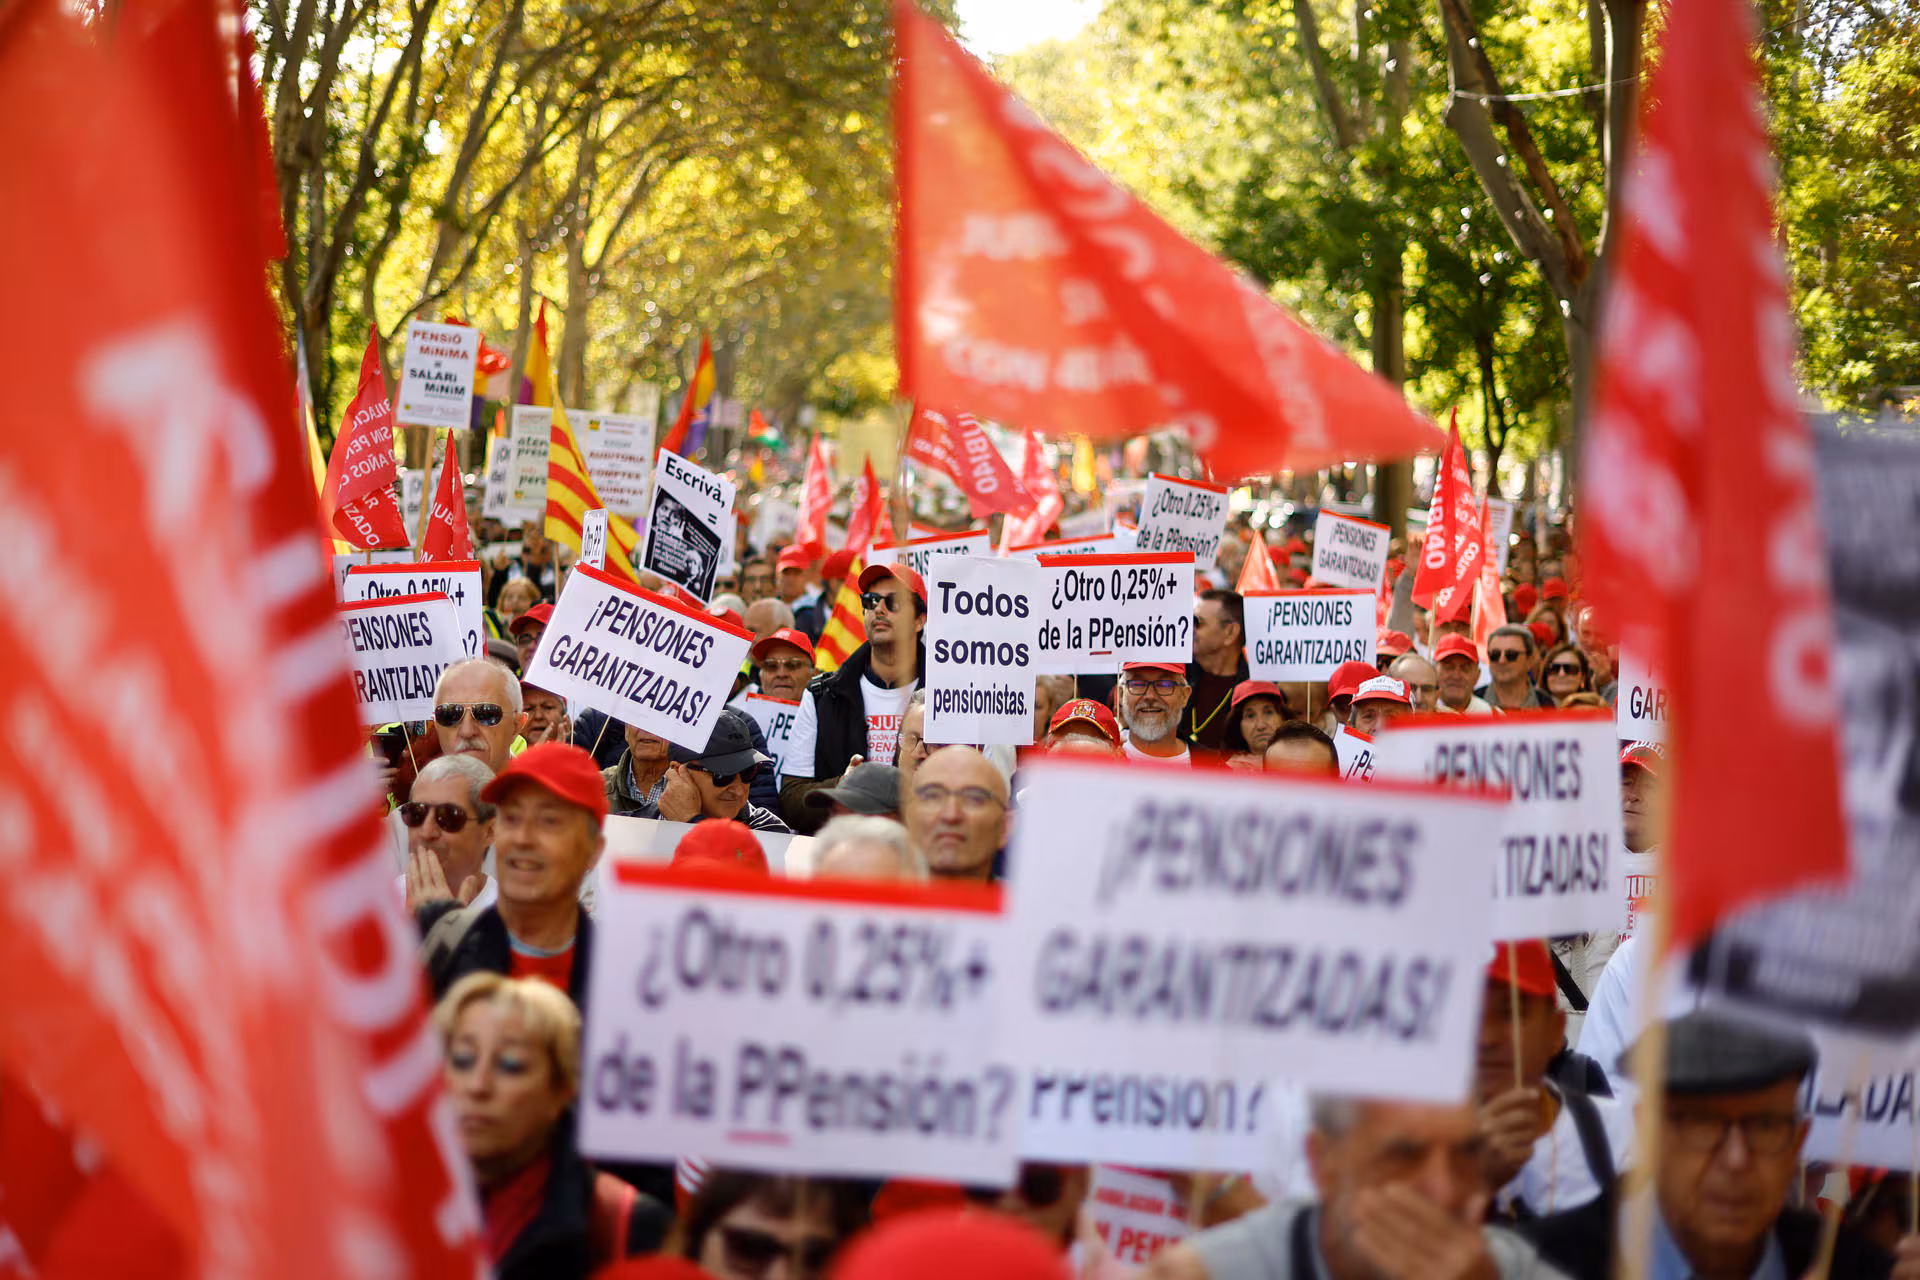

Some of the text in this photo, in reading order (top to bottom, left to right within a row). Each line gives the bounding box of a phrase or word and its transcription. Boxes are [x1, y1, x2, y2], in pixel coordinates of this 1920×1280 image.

[665, 456, 725, 508] Escrivà,
[1152, 488, 1183, 518] ¿Otro
[1137, 523, 1151, 549] de
[1152, 526, 1163, 550] la
[937, 581, 1029, 619] Todos
[1051, 568, 1177, 610] ¿Otro 0,25%+
[345, 611, 433, 651] ENSIONES
[584, 595, 714, 669] ¡PENSIONES
[1038, 615, 1189, 650] de la PPensión?
[1267, 601, 1352, 632] ¡PENSIONES
[934, 638, 1029, 667] somos
[1256, 639, 1367, 664] GARANTIZADAS!
[550, 635, 712, 727] GARANTIZADAS!
[933, 682, 1027, 720] pensionistas.
[1095, 798, 1421, 909] ¡PENSIONES
[1503, 831, 1608, 897] TIZADAS!
[636, 906, 789, 1008] ¿Otro
[1033, 927, 1455, 1042] GARANTIZADAS!
[595, 1032, 657, 1115] de
[672, 1036, 716, 1118] la
